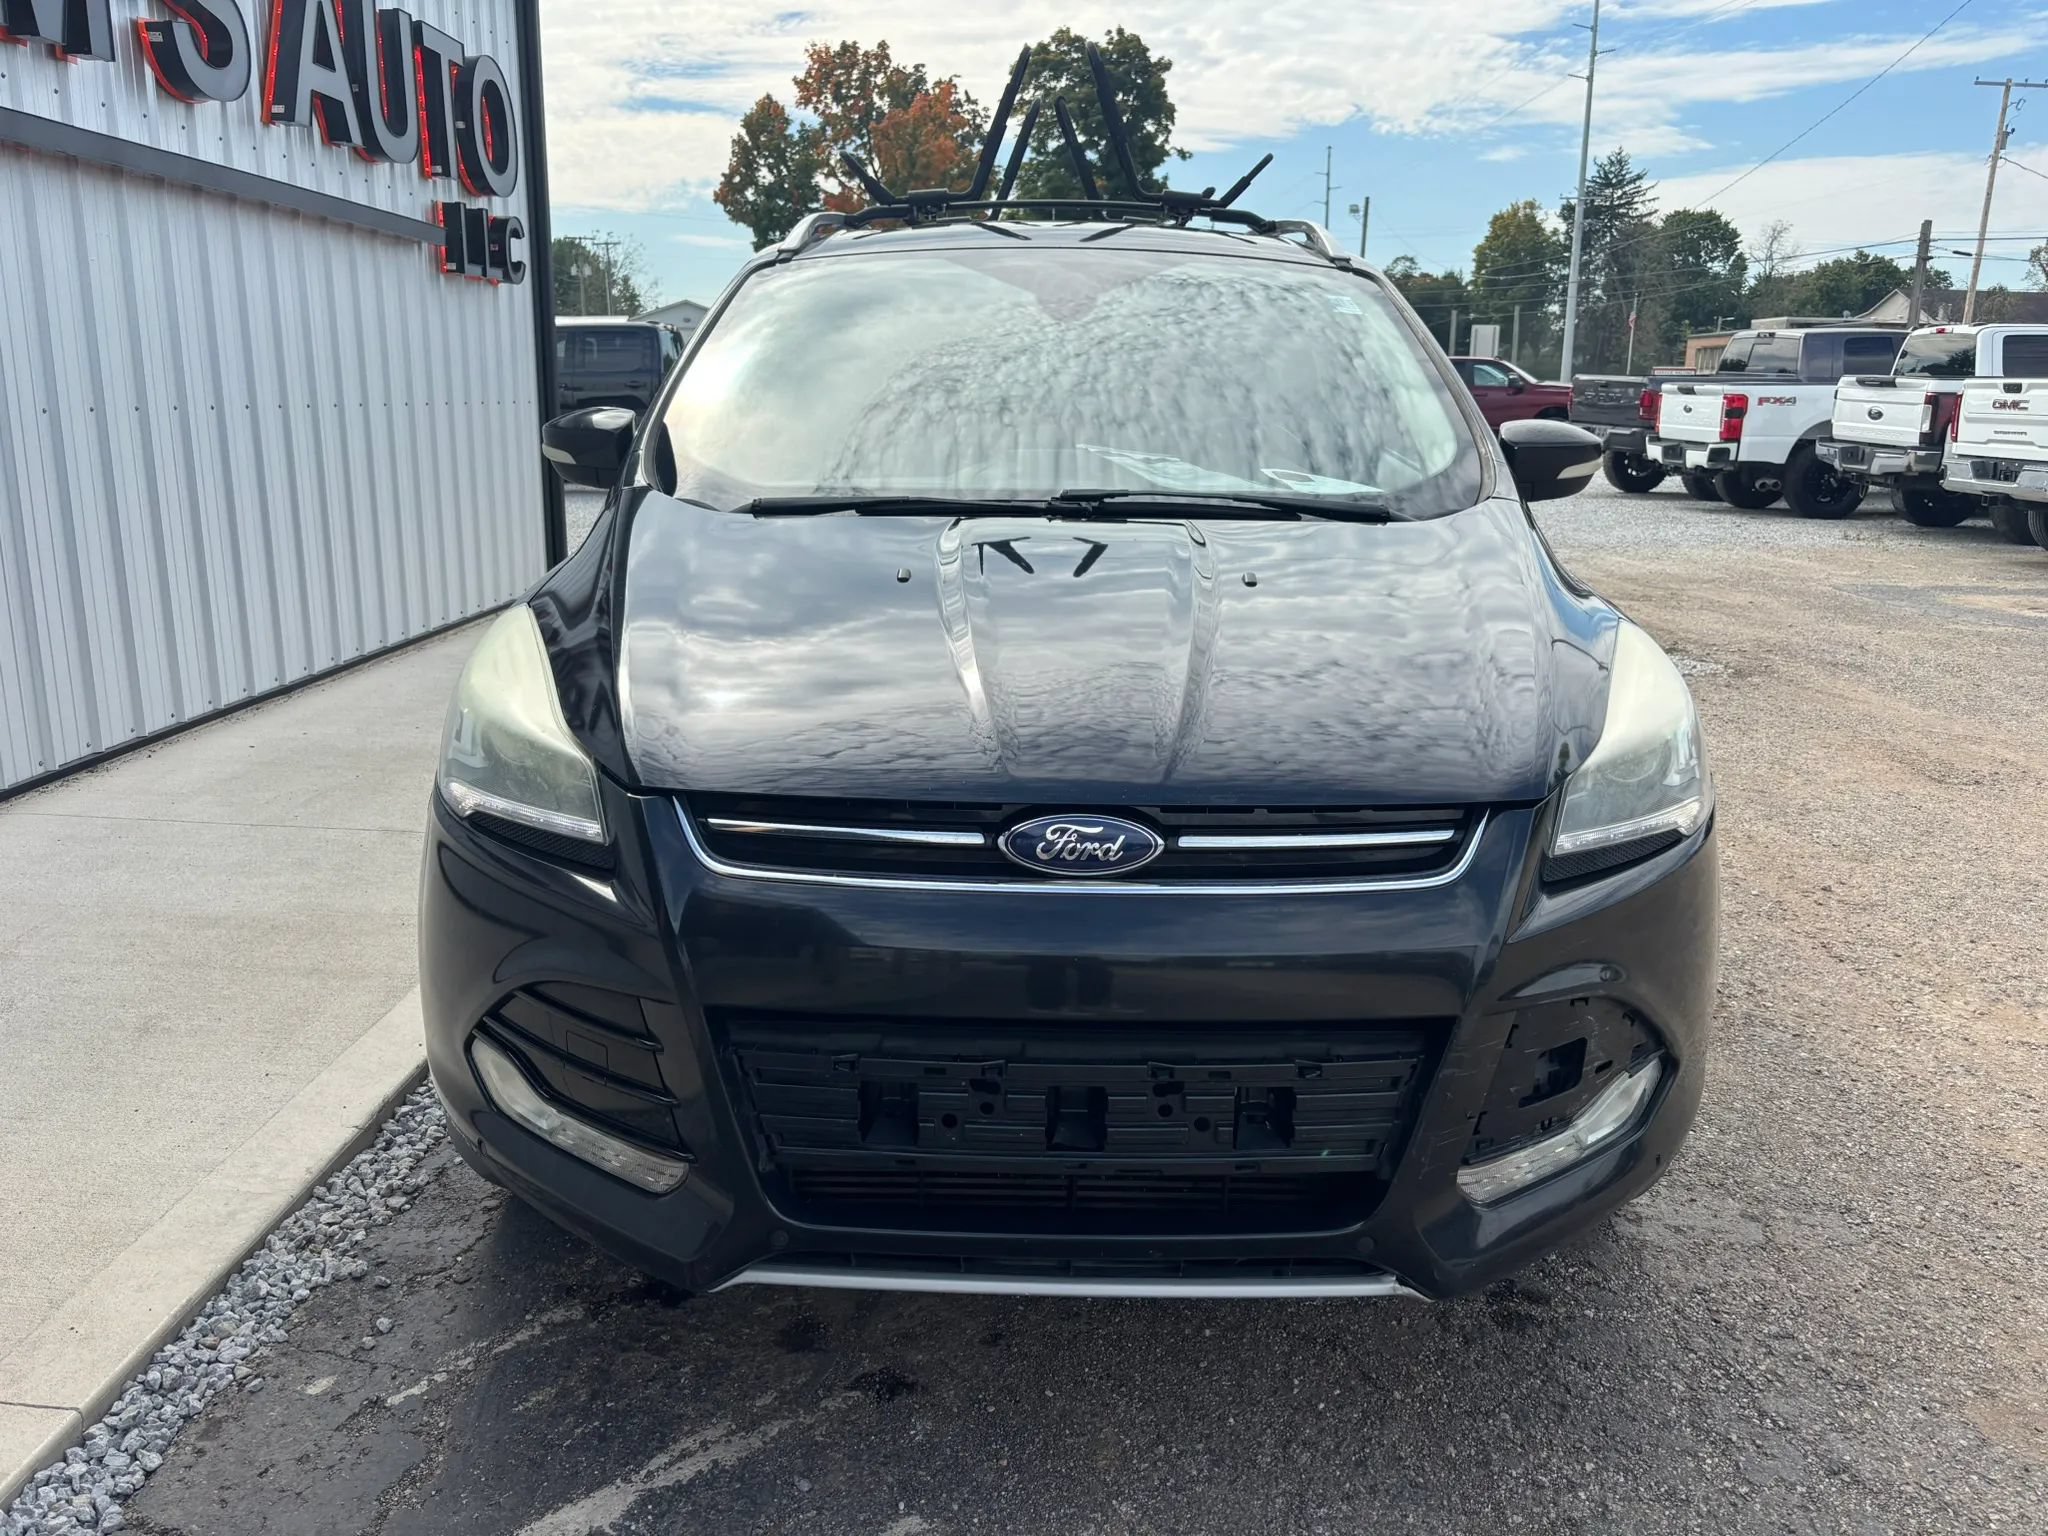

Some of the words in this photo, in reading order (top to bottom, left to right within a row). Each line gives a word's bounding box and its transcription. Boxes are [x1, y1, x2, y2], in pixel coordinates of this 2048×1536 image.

[262, 0, 519, 198] AUTO
[438, 200, 527, 285] LLC
[1757, 396, 1797, 407] FX4
[1992, 398, 2031, 411] GMC
[1035, 823, 1126, 862] Ford
